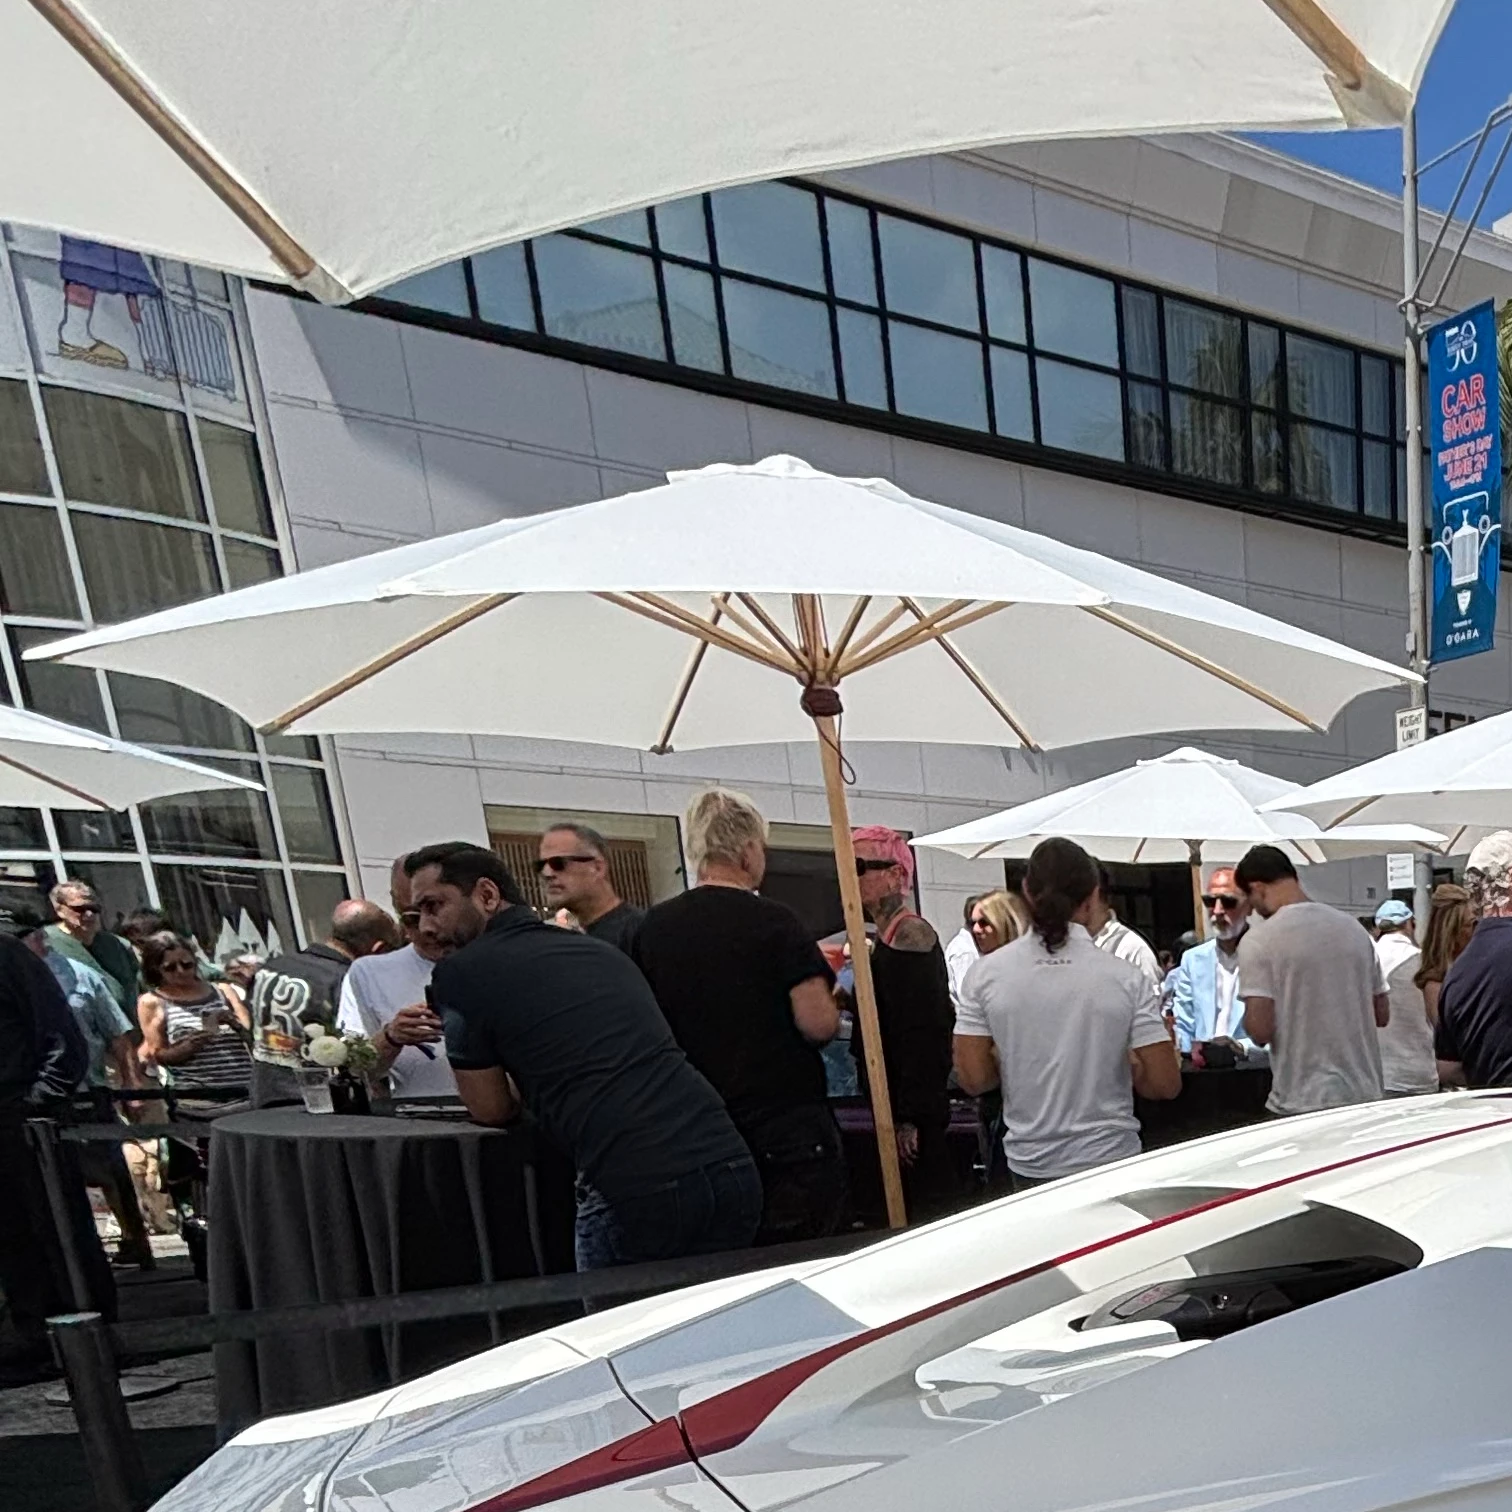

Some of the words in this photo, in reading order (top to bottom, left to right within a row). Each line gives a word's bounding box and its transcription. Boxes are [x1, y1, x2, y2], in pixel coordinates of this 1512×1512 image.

[1441, 373, 1487, 418] CAR
[1442, 406, 1487, 443] SHOW
[1399, 713, 1423, 729] WEIGHT
[1402, 727, 1421, 742] LIMIT
